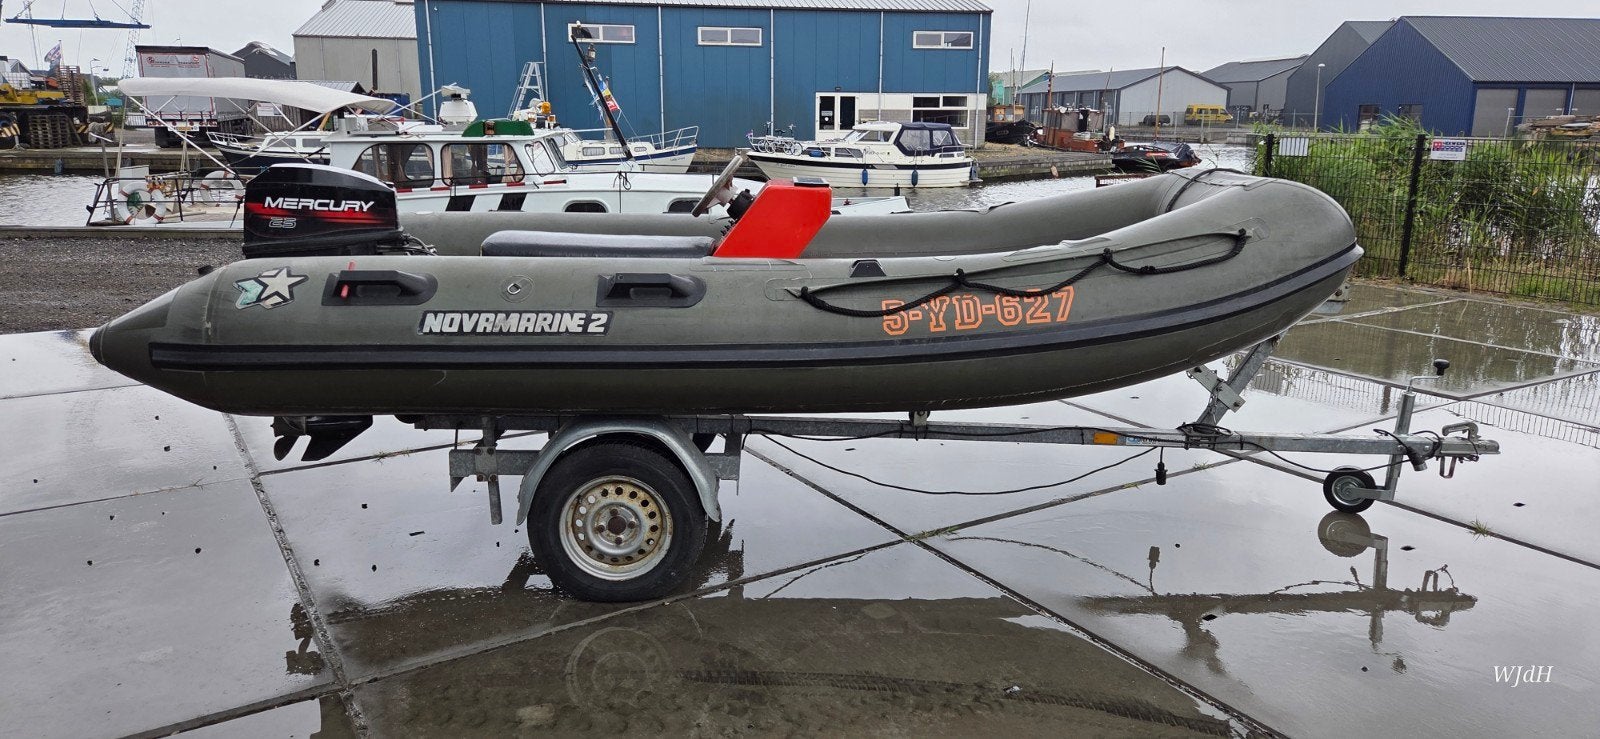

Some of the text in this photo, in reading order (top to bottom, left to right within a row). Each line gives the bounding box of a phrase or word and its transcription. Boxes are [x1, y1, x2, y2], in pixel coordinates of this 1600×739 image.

[264, 196, 375, 213] MERCURY
[268, 216, 297, 229] 25
[881, 285, 1075, 336] 5-YD-627
[422, 312, 608, 333] NOVAMARINE 2
